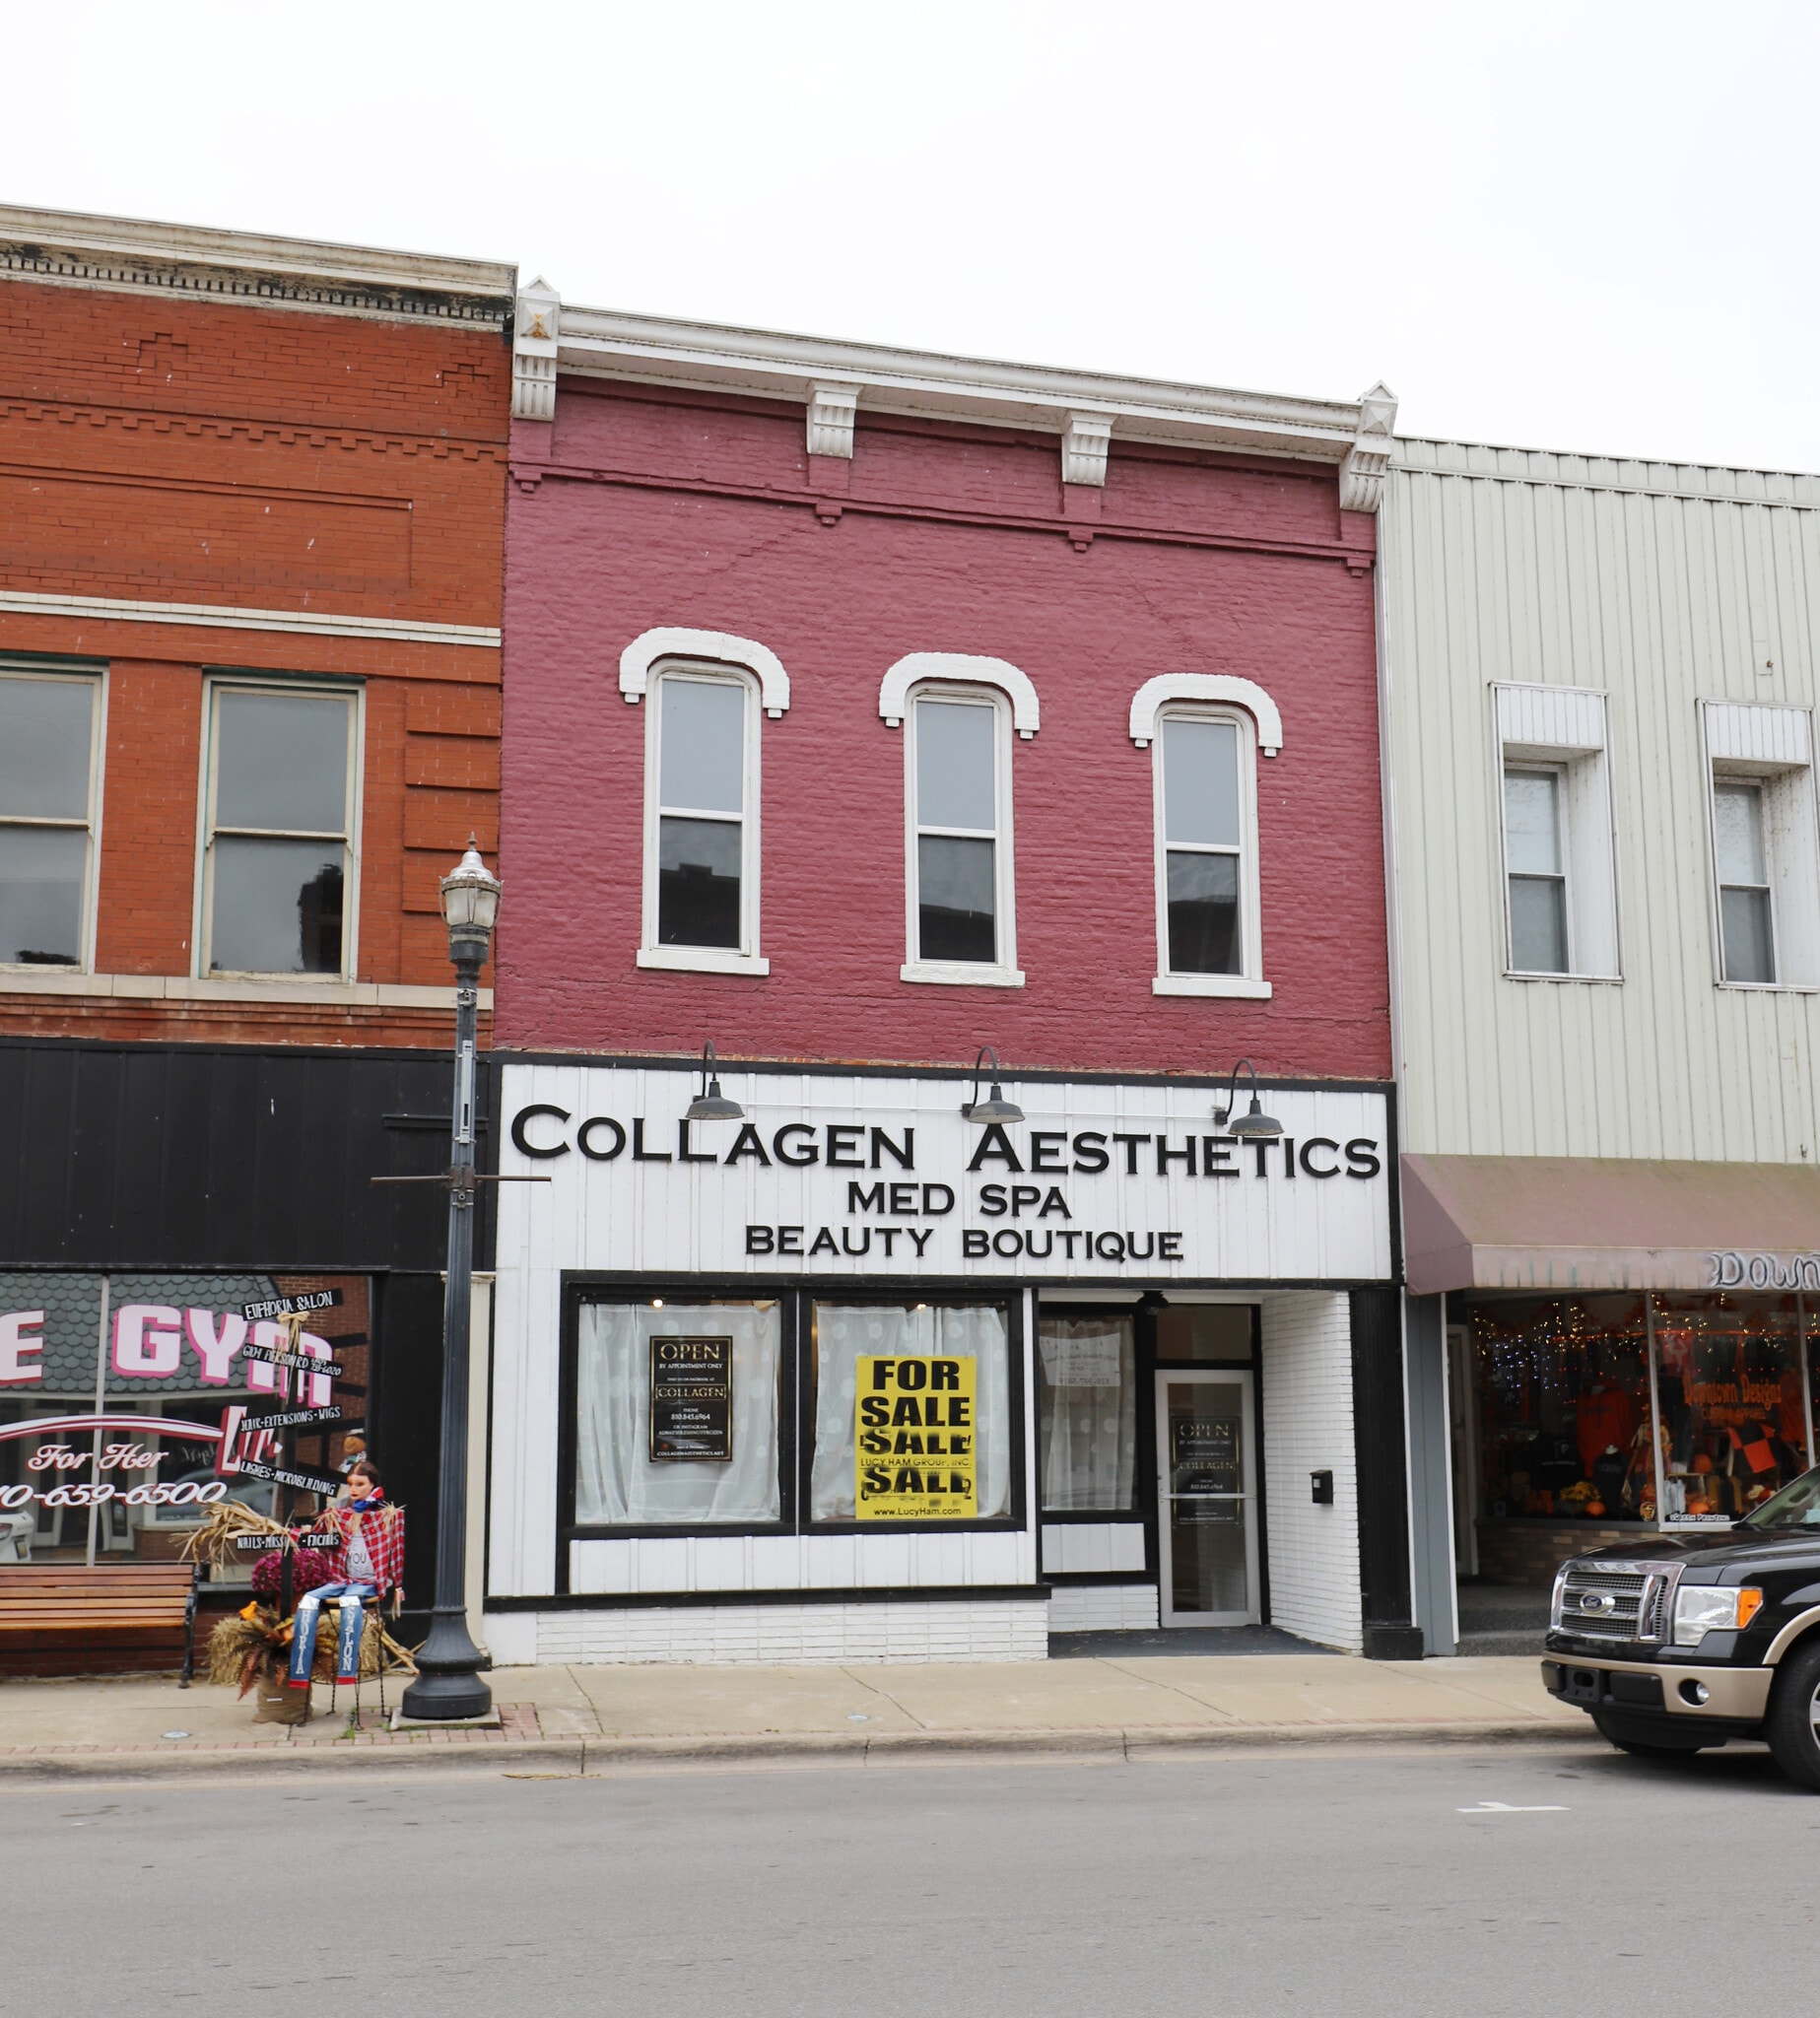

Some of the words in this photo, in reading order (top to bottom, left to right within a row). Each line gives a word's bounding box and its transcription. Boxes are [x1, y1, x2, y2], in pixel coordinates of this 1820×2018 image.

[511, 1104, 916, 1172] COLLAGEN
[966, 1122, 1382, 1179] AESTHETICS
[846, 1180, 955, 1216] MED
[979, 1183, 1072, 1219] SPA
[745, 1225, 934, 1257] BEAUTY
[962, 1229, 1183, 1262] BOUTIQUE
[1712, 1251, 1820, 1290] Down
[244, 1298, 294, 1319] EUPHORIA
[297, 1291, 333, 1312] SALON
[660, 1343, 720, 1360] OPEN
[872, 1360, 960, 1390] FOR
[658, 1386, 724, 1397] COLLAGEN
[861, 1396, 971, 1428] SALE
[27, 1444, 94, 1471] For
[97, 1443, 169, 1471] Her
[0, 1481, 228, 1509] 0-659-6500
[873, 1508, 962, 1517] www.LucyHam.com
